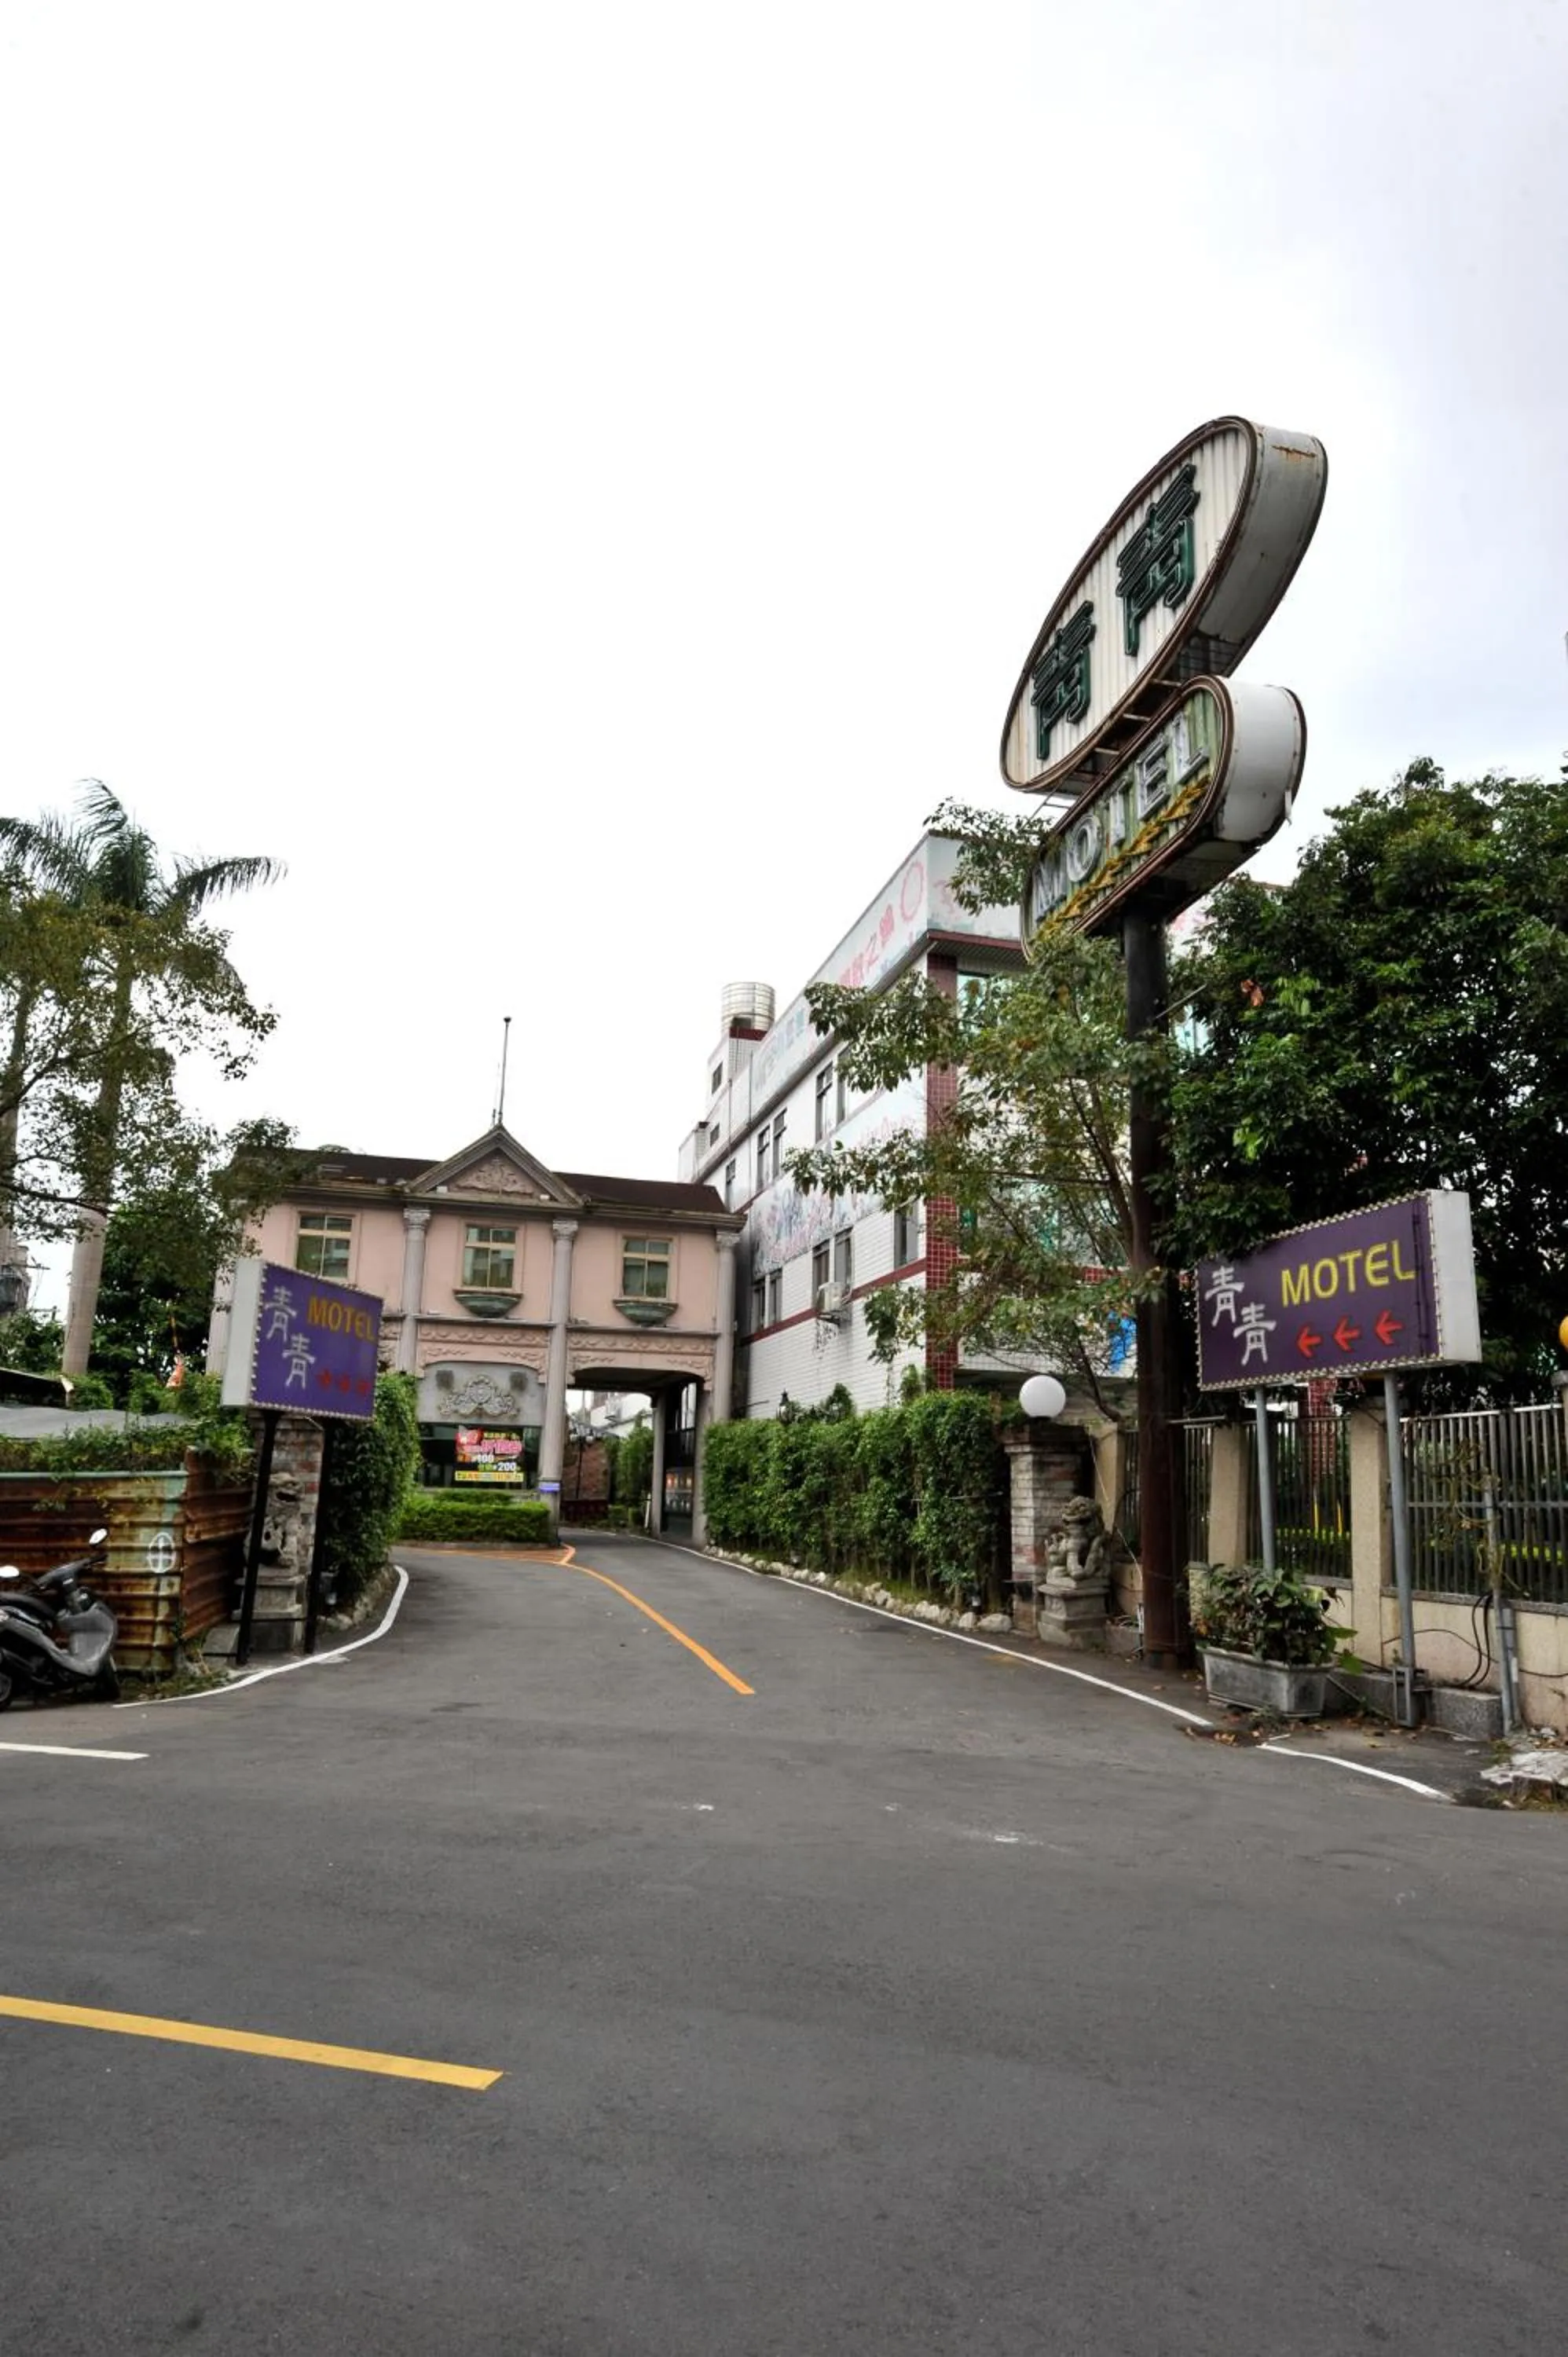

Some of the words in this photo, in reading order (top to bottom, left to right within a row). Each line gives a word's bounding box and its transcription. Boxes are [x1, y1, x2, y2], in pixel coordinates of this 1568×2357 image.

[1031, 462, 1200, 761] 青青
[1032, 709, 1210, 922] MOTEL
[307, 1296, 376, 1340] MOTEL
[1204, 1266, 1277, 1366] 青青
[1280, 1239, 1416, 1307] MOTEL
[264, 1285, 316, 1390] 青青
